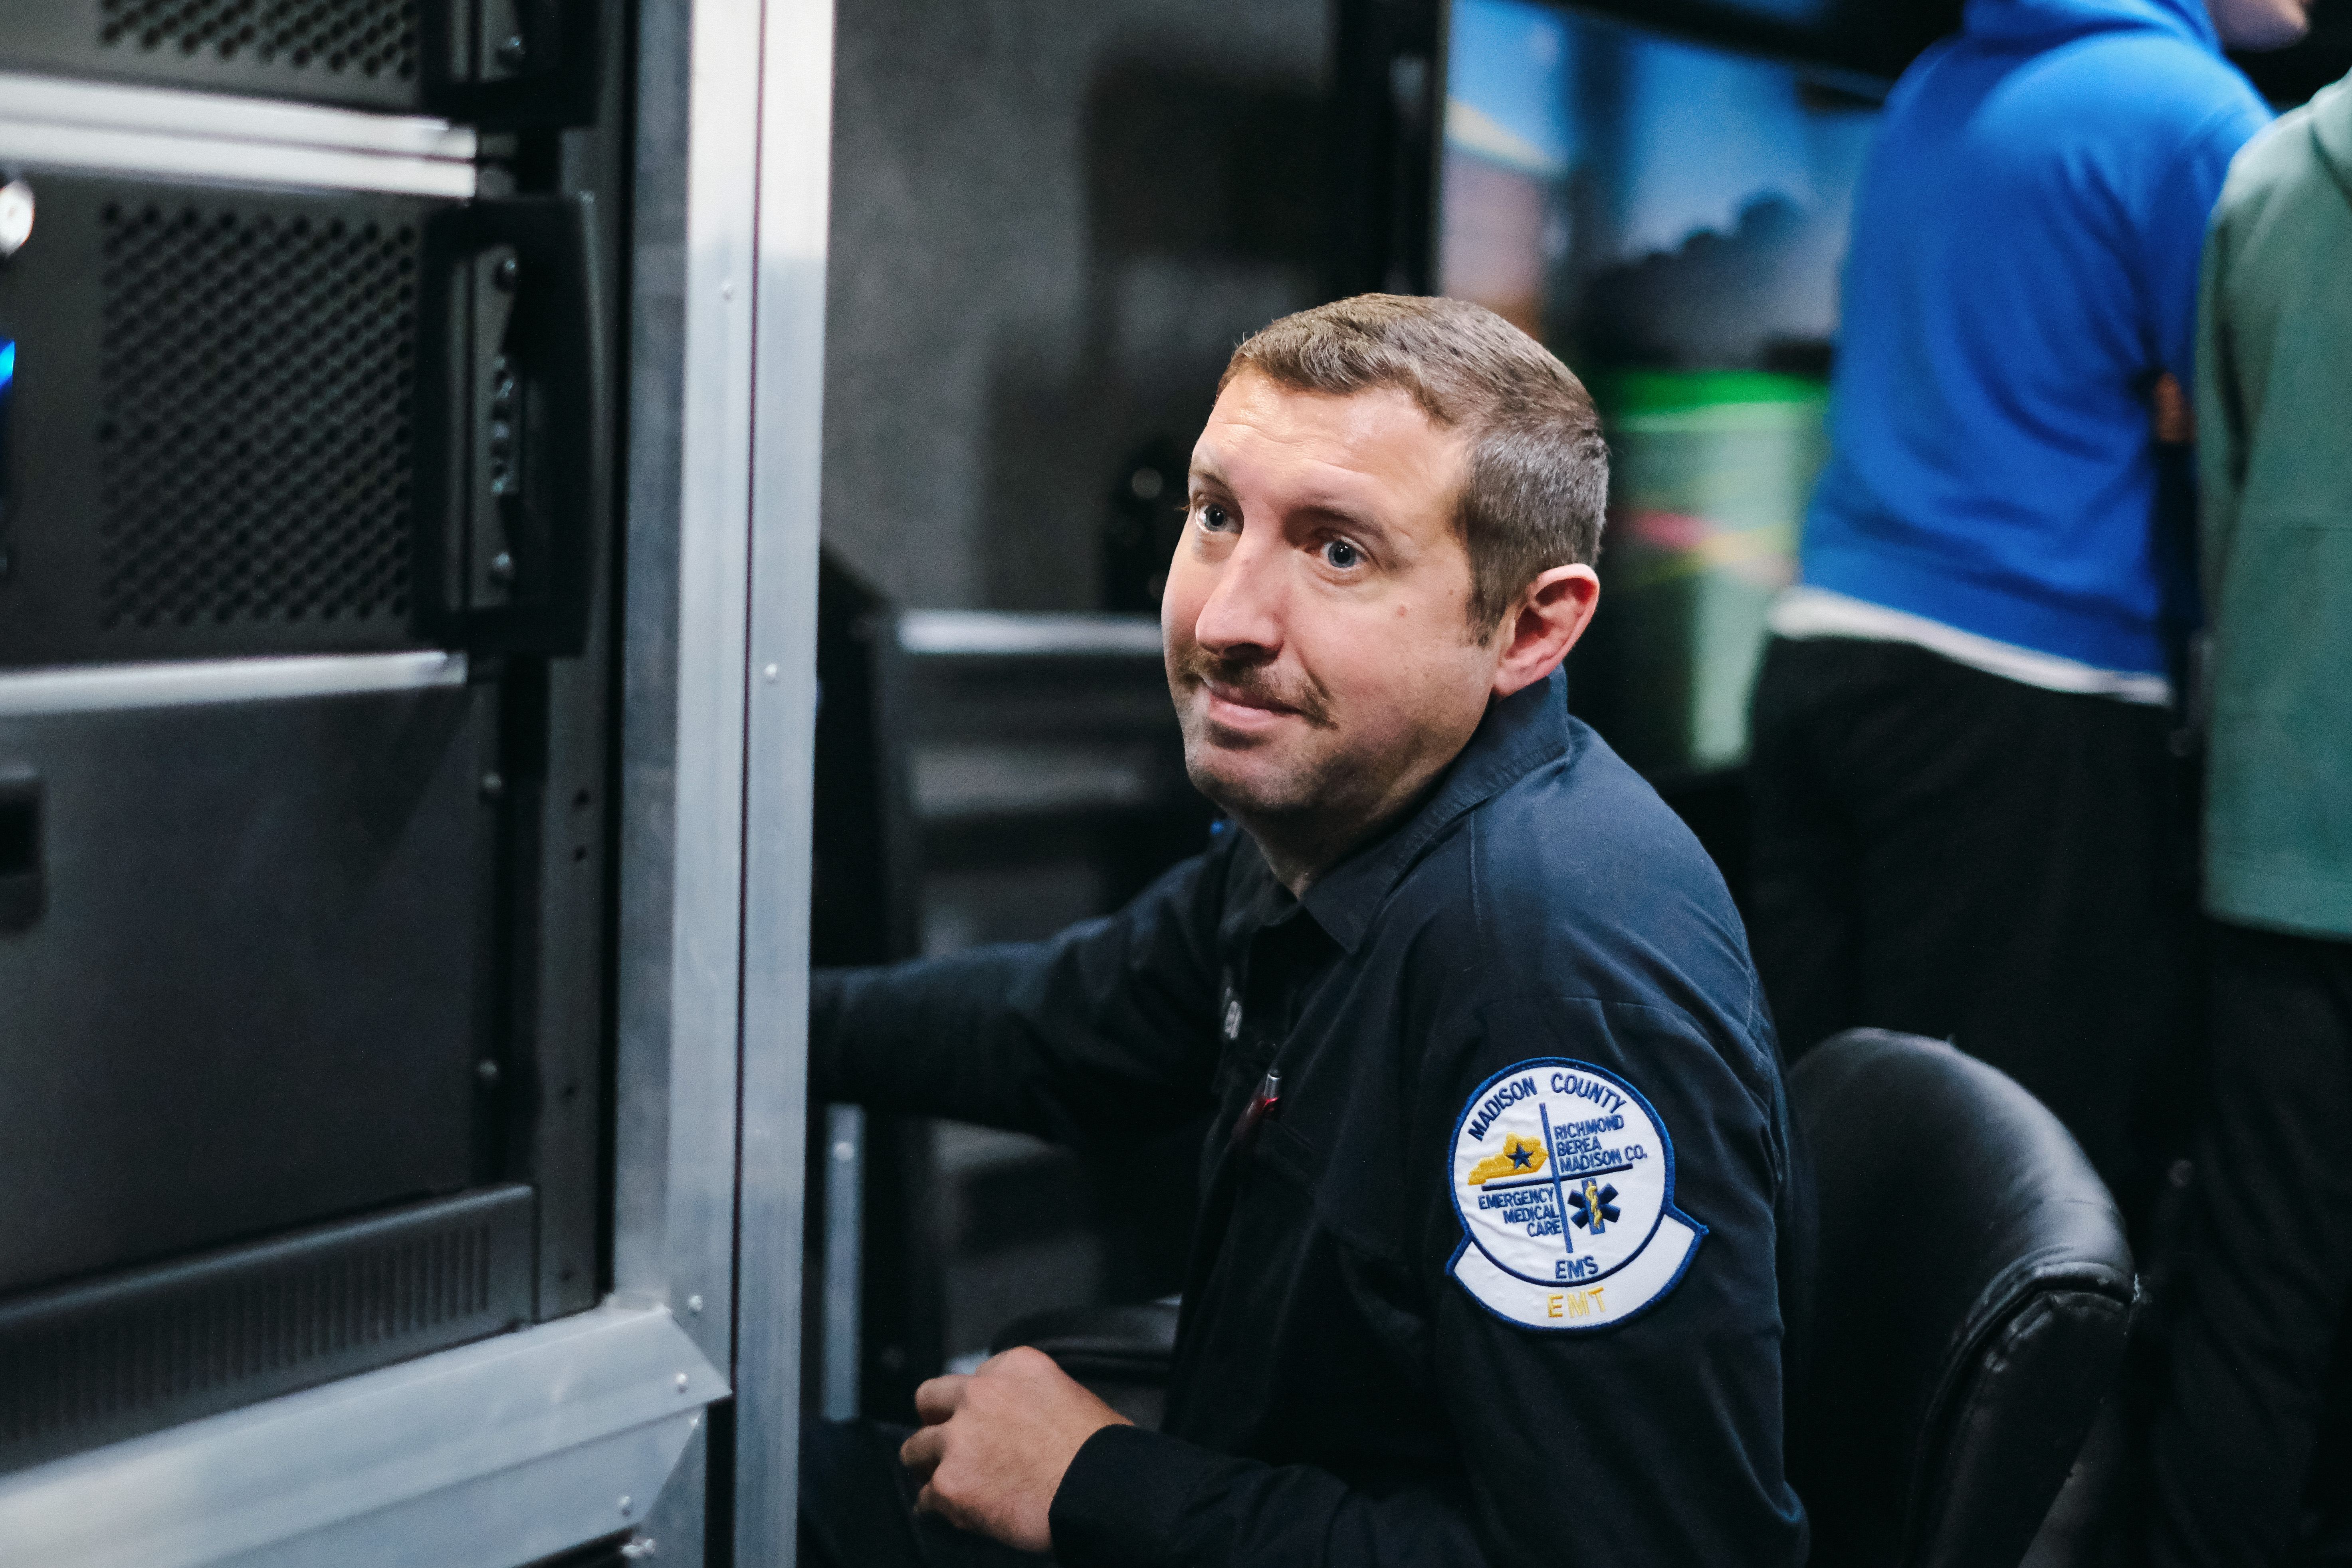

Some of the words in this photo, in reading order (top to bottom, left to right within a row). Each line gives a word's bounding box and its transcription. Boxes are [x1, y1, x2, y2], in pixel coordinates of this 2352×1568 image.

[1468, 1077, 1537, 1141] MADISON
[1551, 1072, 1626, 1113] COUNTY
[1554, 1115, 1624, 1140] RICHMOND
[1557, 1137, 1602, 1157] BEREA
[1559, 1150, 1621, 1173] MADISON
[1625, 1144, 1647, 1162] CO.
[1478, 1188, 1554, 1209] EMERGENCY
[1503, 1205, 1560, 1223] MEDICAL
[1527, 1220, 1561, 1237] CARE
[1555, 1256, 1598, 1279] EMS
[1548, 1286, 1605, 1318] EMT
